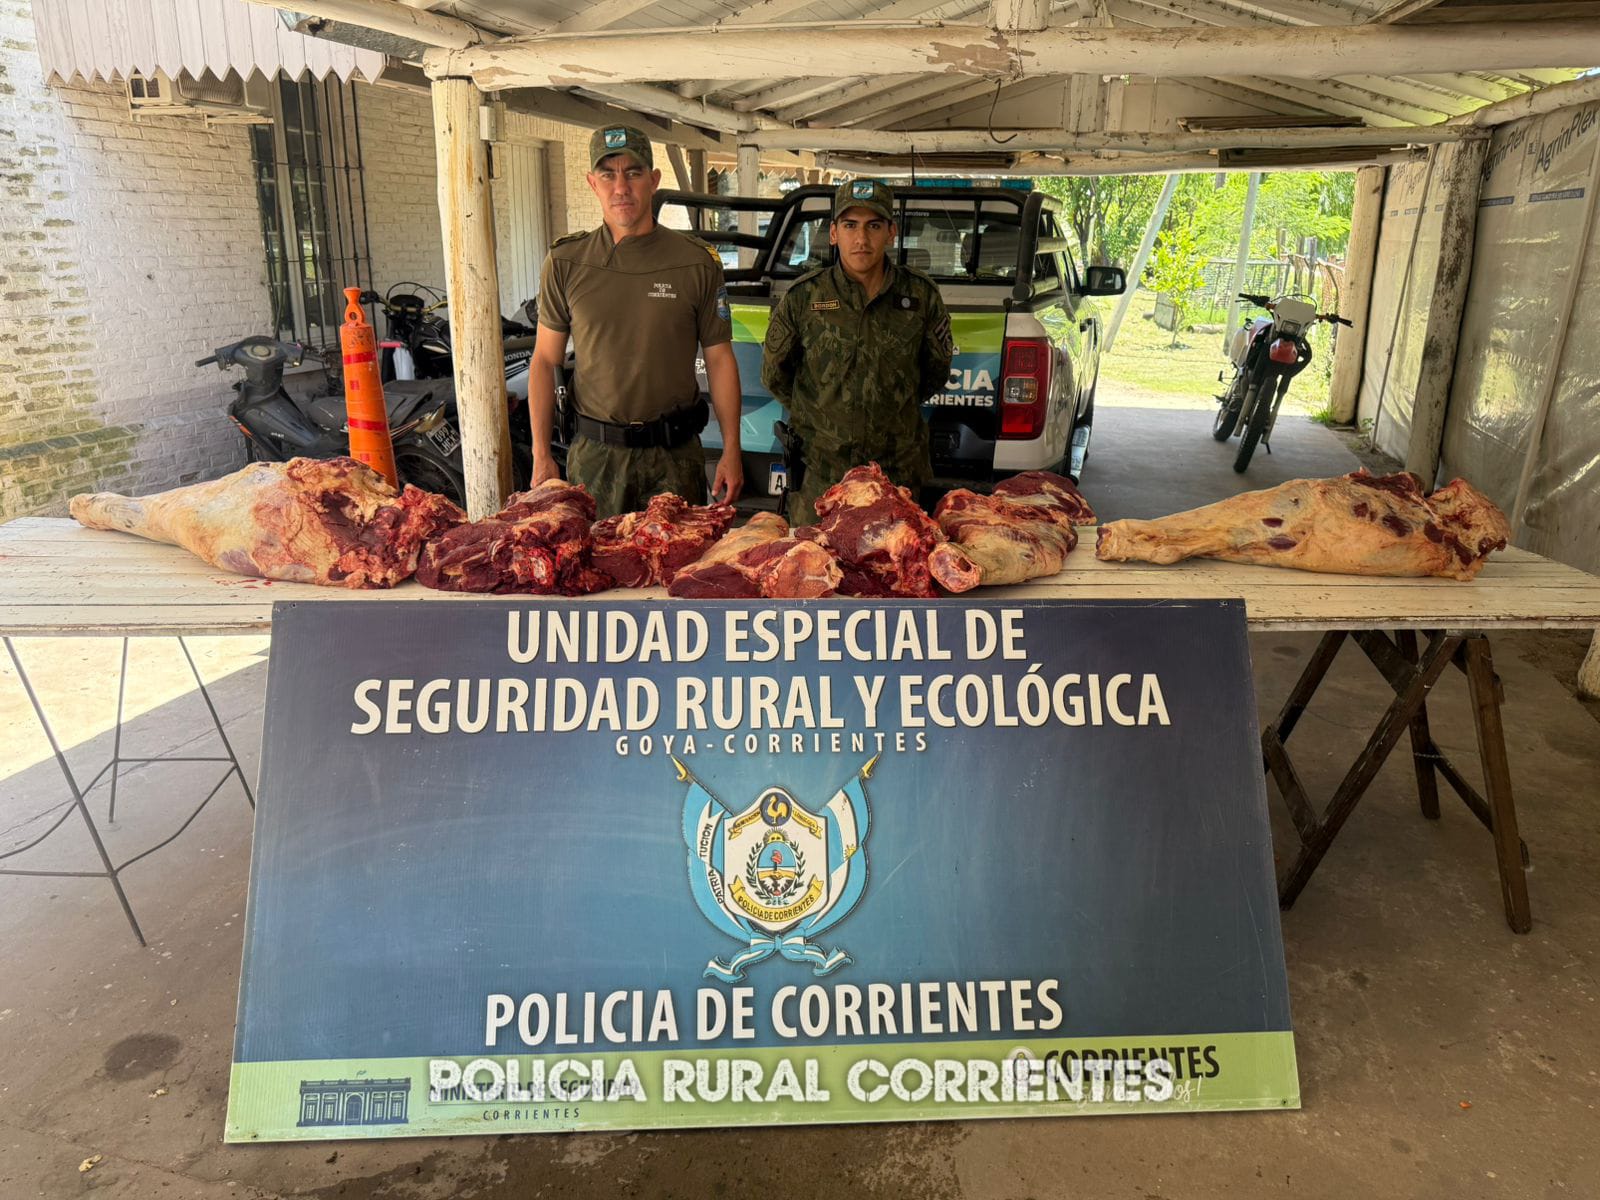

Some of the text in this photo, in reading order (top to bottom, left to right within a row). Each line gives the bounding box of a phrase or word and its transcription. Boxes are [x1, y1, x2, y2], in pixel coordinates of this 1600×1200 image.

[924, 393, 994, 407] RIENTES
[507, 608, 1027, 664] UNIDAD ESPECIAL DE
[350, 663, 1171, 735] SEGURIDAD RURAL Y ECOLÓGICA
[485, 978, 1063, 1047] POLICIA DE CORRIENTES
[482, 1107, 581, 1121] CORRIENTES
